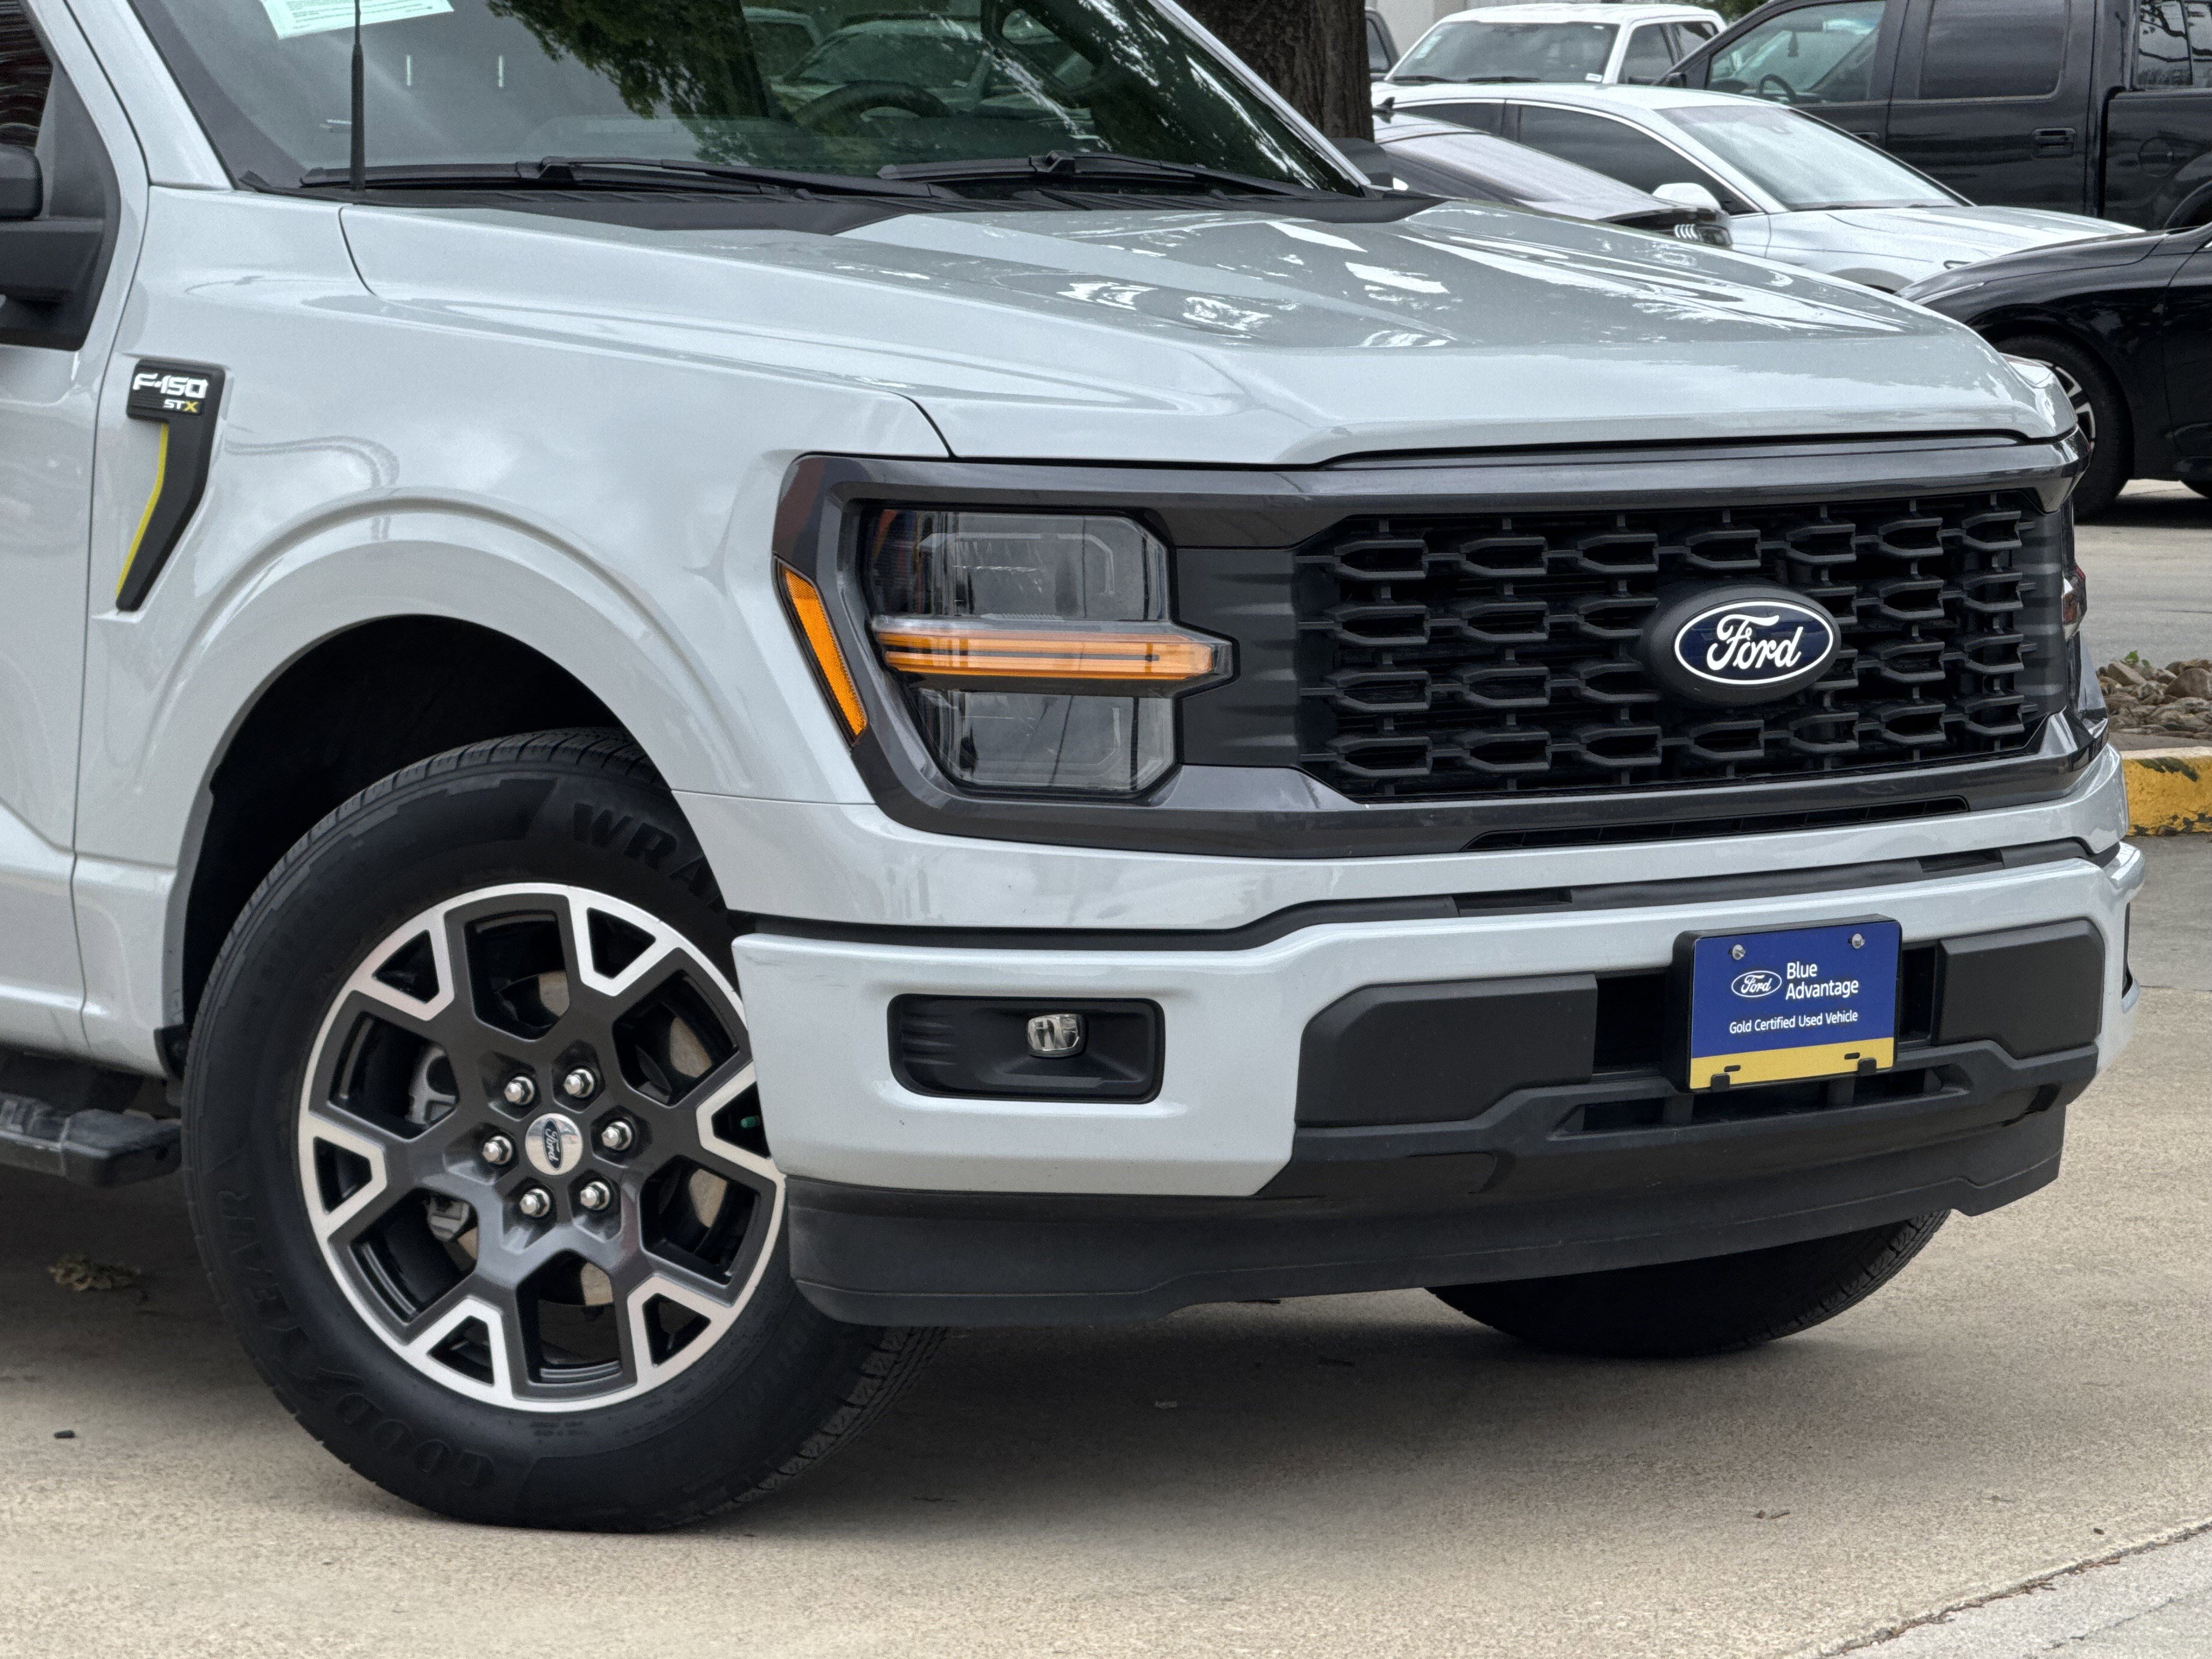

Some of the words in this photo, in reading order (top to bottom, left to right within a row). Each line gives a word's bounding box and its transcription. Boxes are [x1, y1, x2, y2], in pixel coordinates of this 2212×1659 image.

[133, 373, 208, 399] F-150
[163, 399, 199, 413] STX
[1707, 614, 1803, 670] Ford
[1786, 961, 1818, 980] Blue
[1741, 974, 1773, 994] Ford
[1785, 979, 1860, 1001] Advantage
[1729, 1019, 1752, 1035] Gold
[1754, 1014, 1796, 1032] Certified
[1798, 1012, 1823, 1028] Used
[1825, 1009, 1859, 1024] Vehicle
